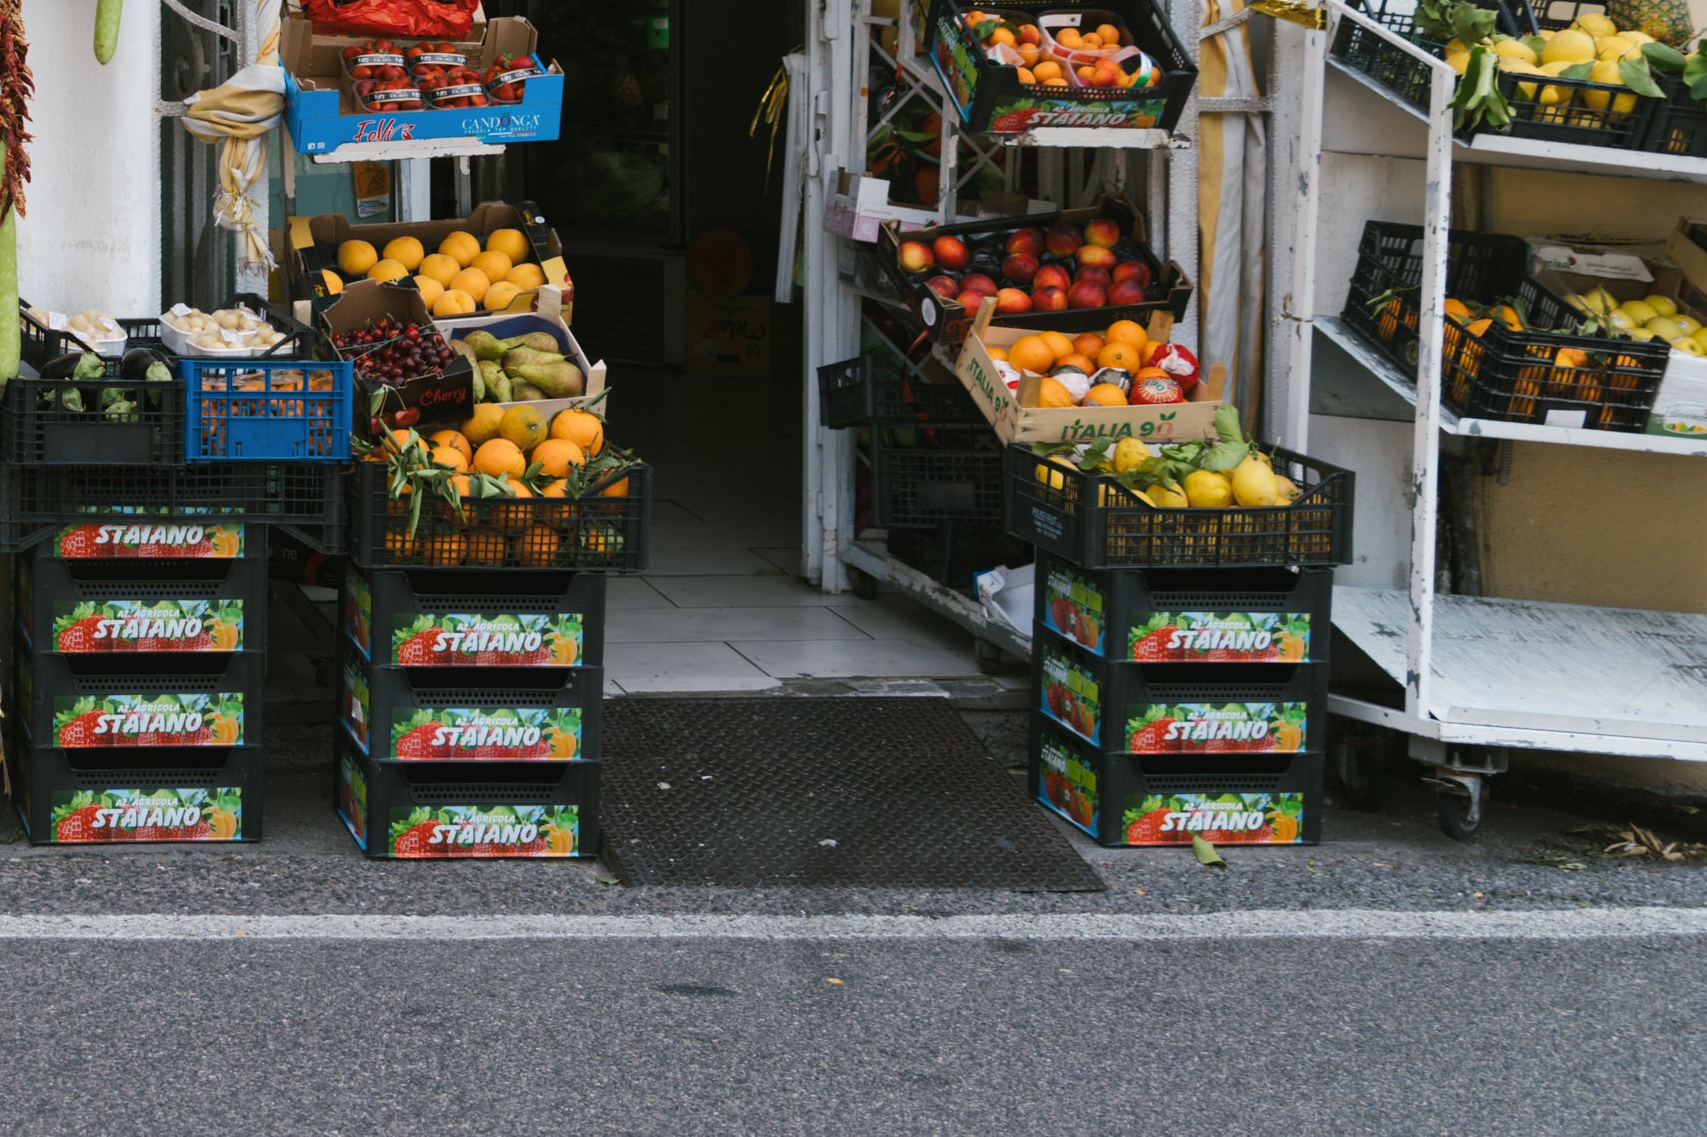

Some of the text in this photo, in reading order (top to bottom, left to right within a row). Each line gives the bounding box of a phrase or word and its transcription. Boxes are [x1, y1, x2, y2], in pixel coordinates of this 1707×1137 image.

[462, 114, 539, 131] CANDONGA
[1026, 112, 1126, 125] STAIANO
[967, 358, 994, 403] ITALIA
[420, 388, 466, 407] Cherry
[1061, 420, 1174, 440] ITALIA 90
[95, 525, 204, 544] STAIANO
[134, 609, 180, 618] AGRICOLA
[94, 619, 203, 639] STAIANO
[473, 623, 520, 631] AGRICOLA
[1206, 621, 1251, 629] AGRICOLA
[433, 632, 542, 652] STAIANO
[1167, 630, 1272, 651] STAIANO
[134, 703, 180, 712] AGRICOLA
[1203, 711, 1247, 720] AGRICOLA
[95, 713, 203, 734] STAIANO
[472, 717, 518, 726] AGRICOLA
[1164, 721, 1269, 741] STAIANO
[432, 727, 541, 747] STAIANO
[132, 798, 178, 806] AGRICOLA
[1199, 801, 1243, 810] AGRICOLA
[91, 807, 201, 828] STAIANO
[469, 814, 516, 823] AGRICOLA
[1160, 811, 1265, 832] STAIANO
[429, 825, 538, 845] STAIANO
